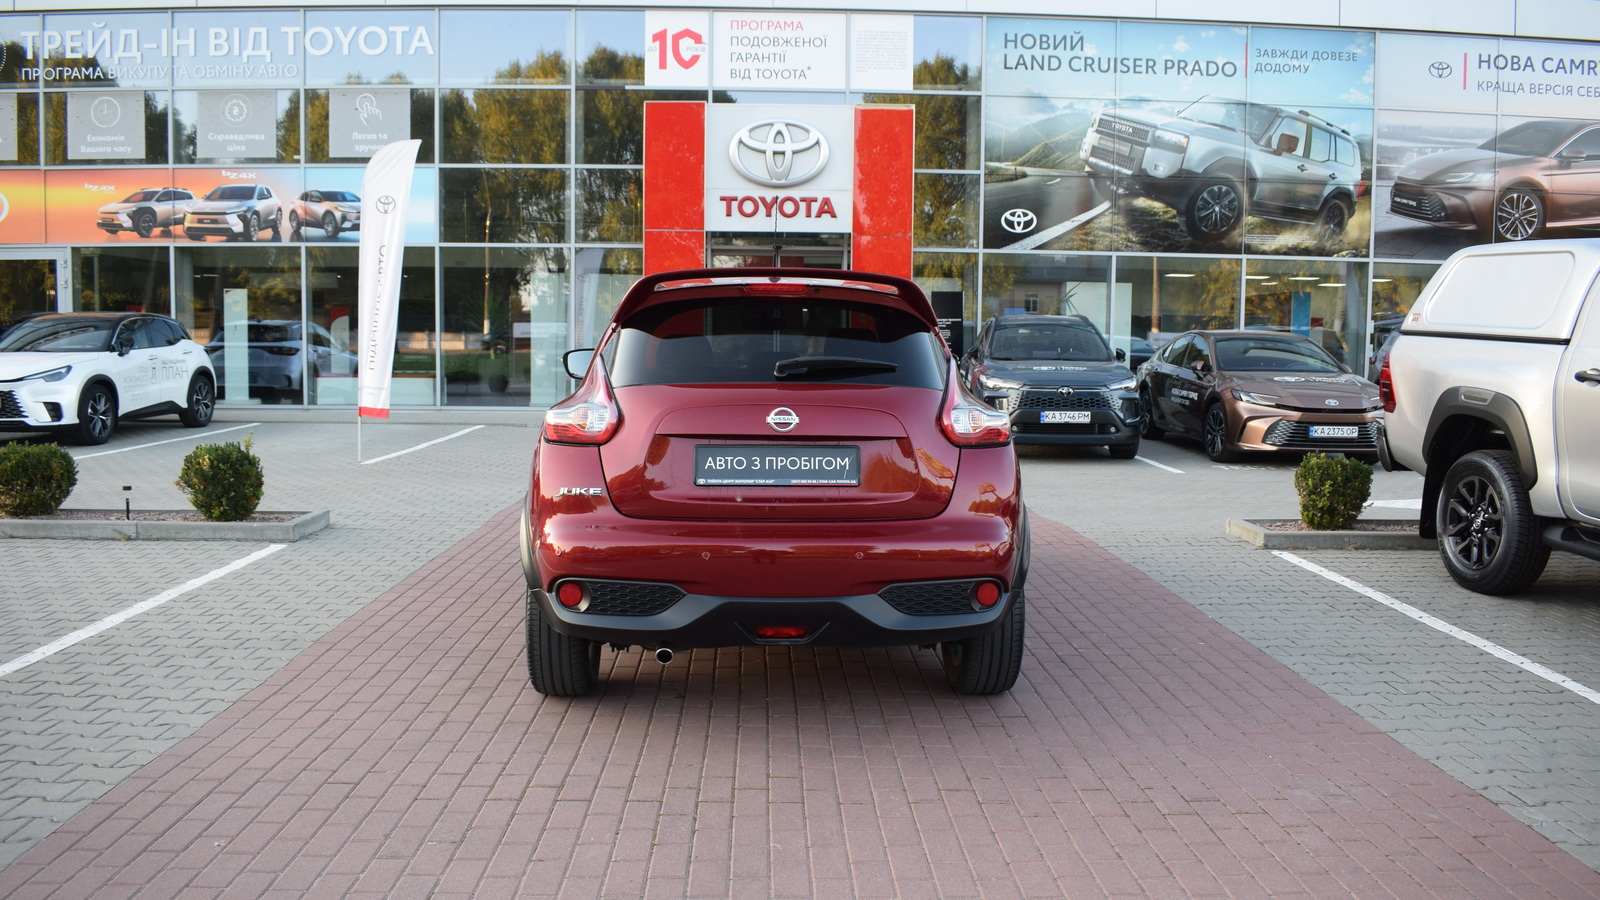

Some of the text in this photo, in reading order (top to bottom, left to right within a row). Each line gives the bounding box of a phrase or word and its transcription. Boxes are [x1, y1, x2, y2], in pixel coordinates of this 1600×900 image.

[730, 20, 804, 31] ПРОГРАМА
[20, 22, 435, 64] ТРЕЙД-ІН ВІД TOYOTA
[730, 34, 828, 48] ПОДОВЖЕНОЇ
[1004, 30, 1084, 52] НОВИЙ
[730, 50, 787, 63] ГАРАНТІЇ
[1255, 48, 1358, 62] ЗАВЖДИ ДОВЕЗЕ
[1003, 53, 1238, 78] LAND CRUISER PRADO
[1254, 62, 1310, 74] ДОДОМУ
[1478, 53, 1600, 76] НОВА CAMR
[22, 64, 298, 81] ПРОГРАМА ВИКУПУ ТА ОБМІНУ АВТО
[730, 68, 752, 80] ВІД
[1477, 80, 1526, 95] КРАЩА
[1529, 82, 1573, 96] ВЕРСІЯ
[1112, 122, 1132, 133] TOYOTA
[720, 196, 838, 218] TOYOTA
[704, 456, 850, 470] АВТО З ПРОБІГОМ
[554, 487, 602, 497] JUKE
